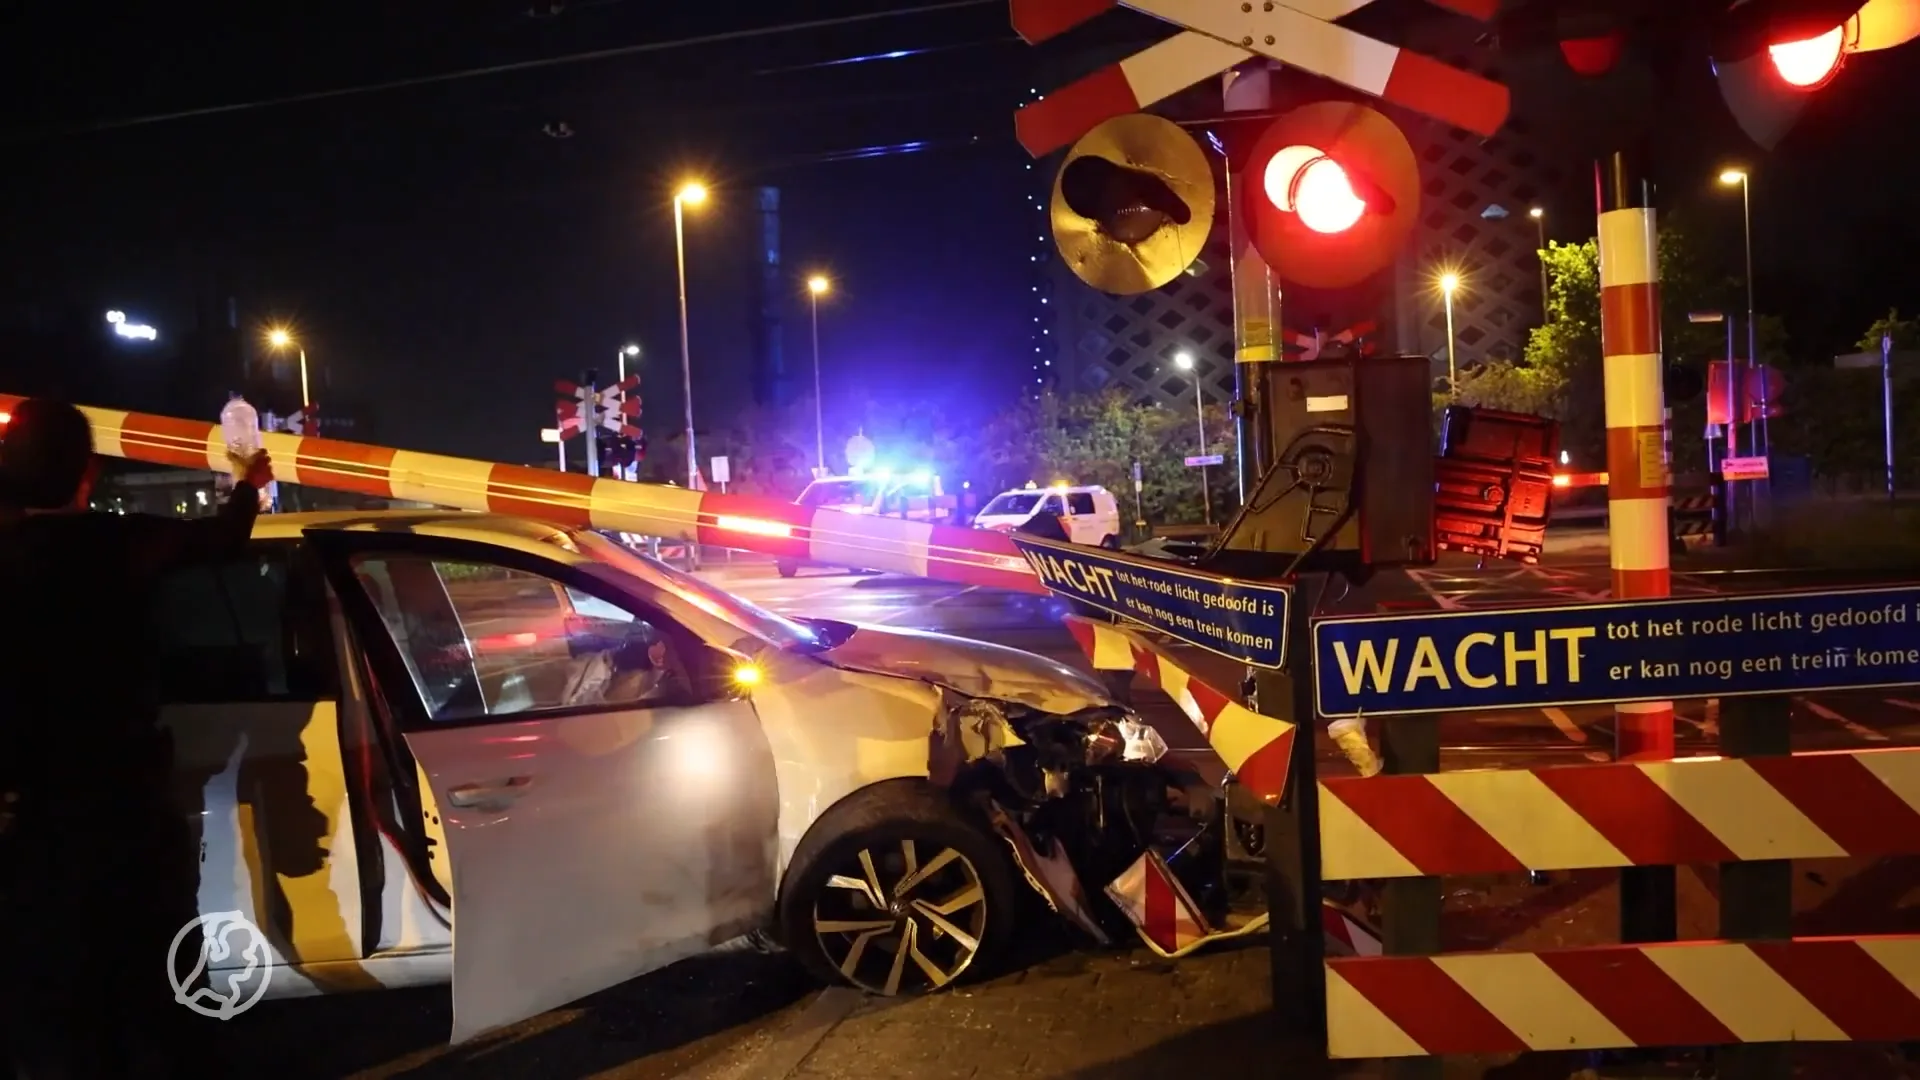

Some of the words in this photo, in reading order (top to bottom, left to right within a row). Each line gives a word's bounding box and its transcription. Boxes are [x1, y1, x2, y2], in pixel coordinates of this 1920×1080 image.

[1023, 548, 1117, 603] WACHT
[1116, 569, 1130, 584] tot
[1131, 572, 1149, 590] het
[1150, 580, 1173, 597] rode
[1174, 583, 1201, 603] licht
[1203, 594, 1257, 615] gedoofd
[1262, 600, 1275, 617] is
[1126, 597, 1137, 608] er
[1138, 599, 1153, 618] kan
[1155, 608, 1174, 626] nog
[1175, 615, 1195, 630] een
[1196, 620, 1223, 640] trein
[1226, 630, 1273, 650] komen
[1332, 626, 1596, 695] WACHT
[1607, 622, 1639, 639] tot
[1647, 619, 1683, 637] het
[1692, 615, 1743, 635] rode
[1752, 611, 1802, 631] licht
[1810, 604, 1906, 633] gedoofd
[1609, 664, 1632, 680] er
[1640, 659, 1680, 678] kan
[1689, 657, 1732, 680] nog
[1741, 655, 1782, 672] een
[1791, 649, 1847, 669] trein
[1857, 647, 1920, 667] kome
